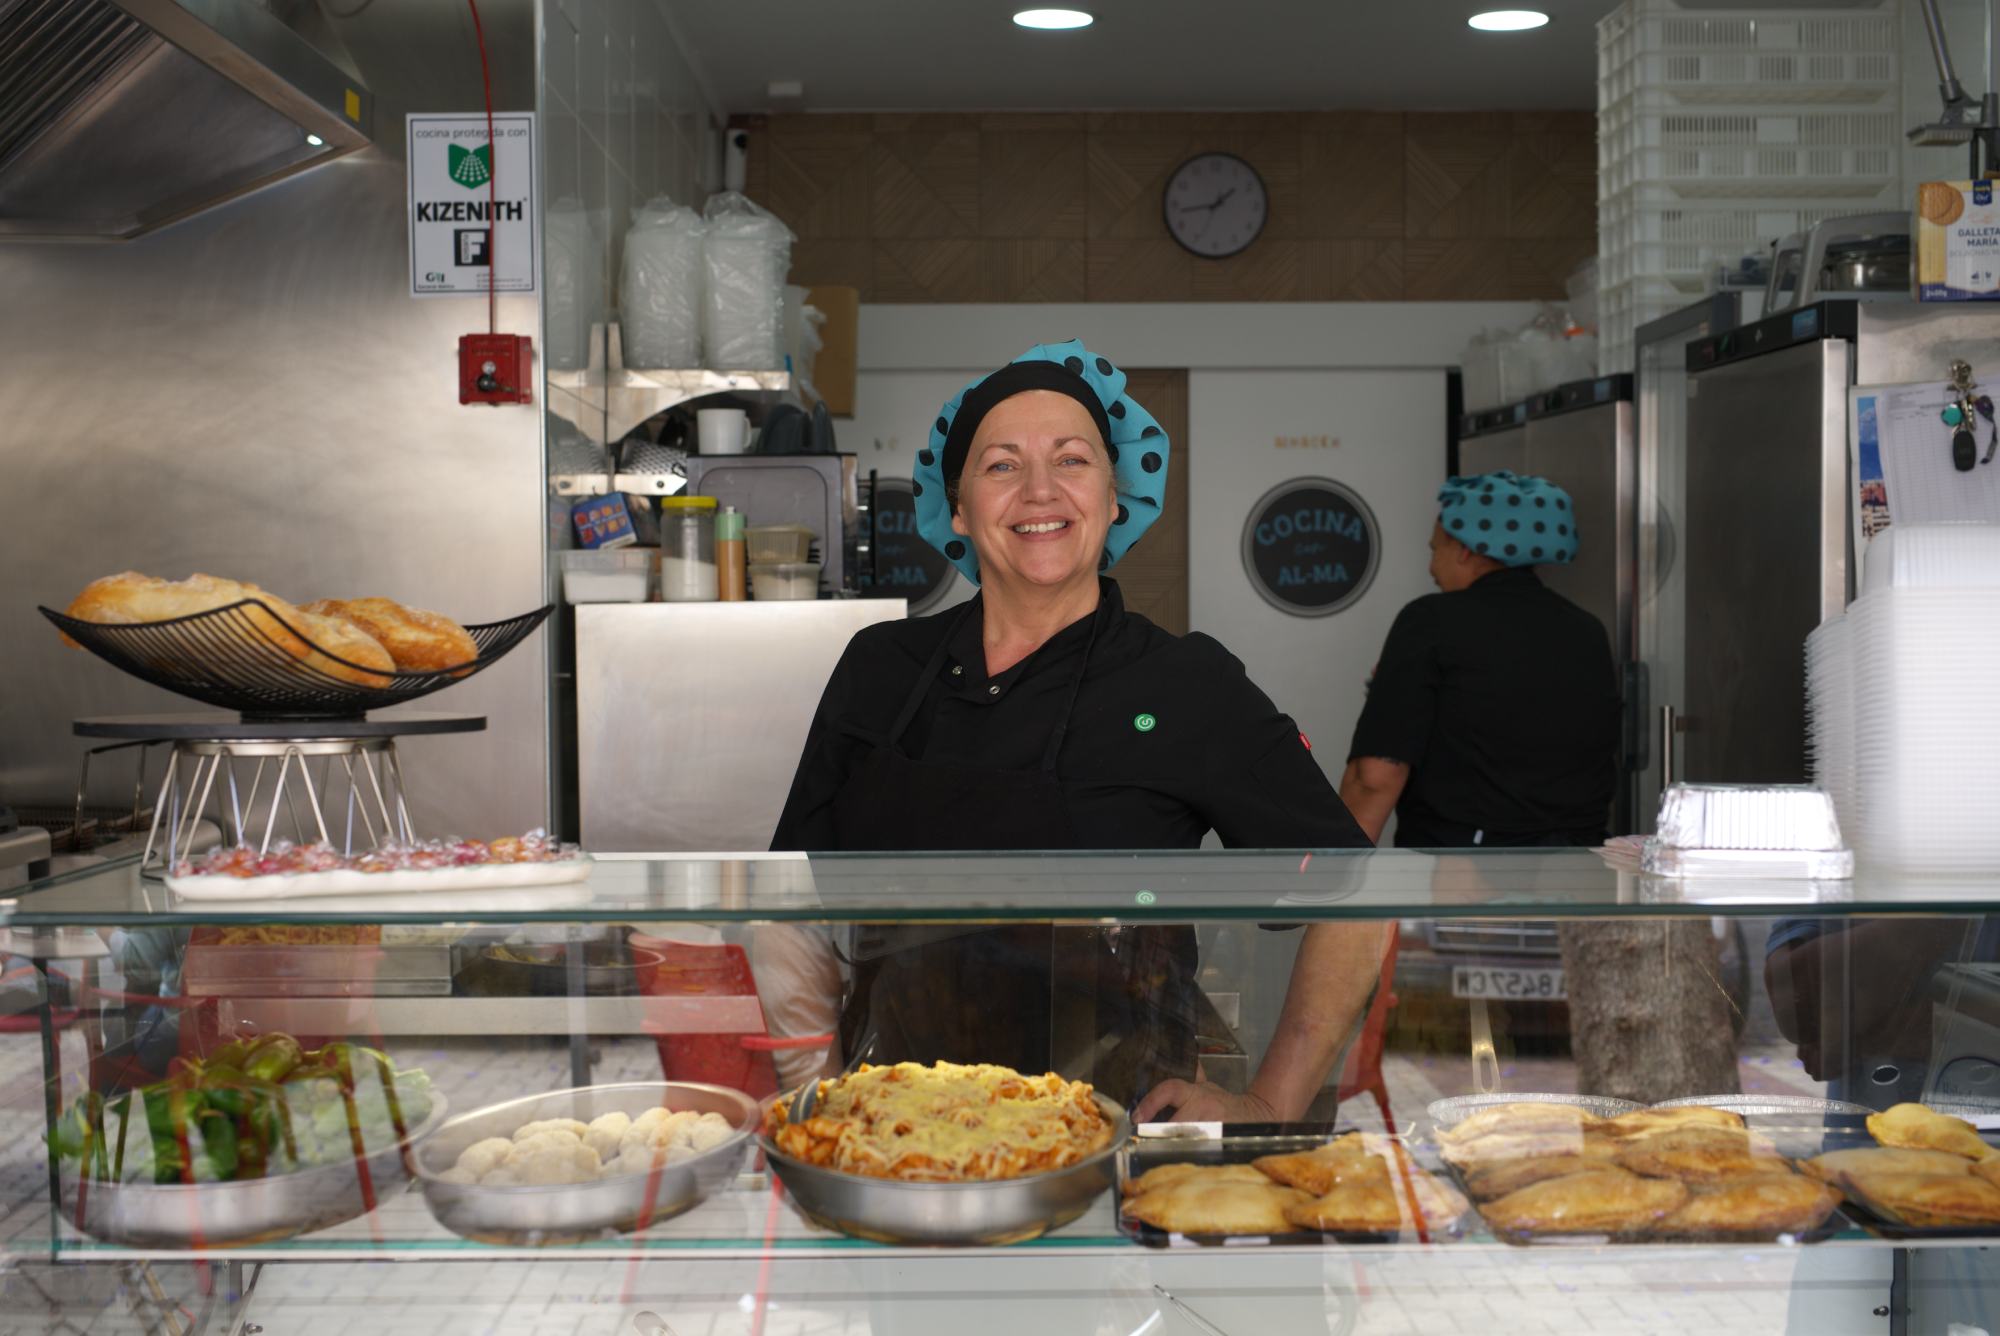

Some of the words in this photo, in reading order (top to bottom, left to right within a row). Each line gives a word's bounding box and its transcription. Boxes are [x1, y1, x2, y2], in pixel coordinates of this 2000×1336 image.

[416, 127, 450, 138] cocina
[452, 126, 505, 140] protegda
[507, 128, 528, 138] con
[417, 201, 523, 223] KIZENITH
[1967, 236, 1999, 247] MARÍA
[1255, 509, 1363, 546] COCINA
[1278, 562, 1348, 587] AL-MA
